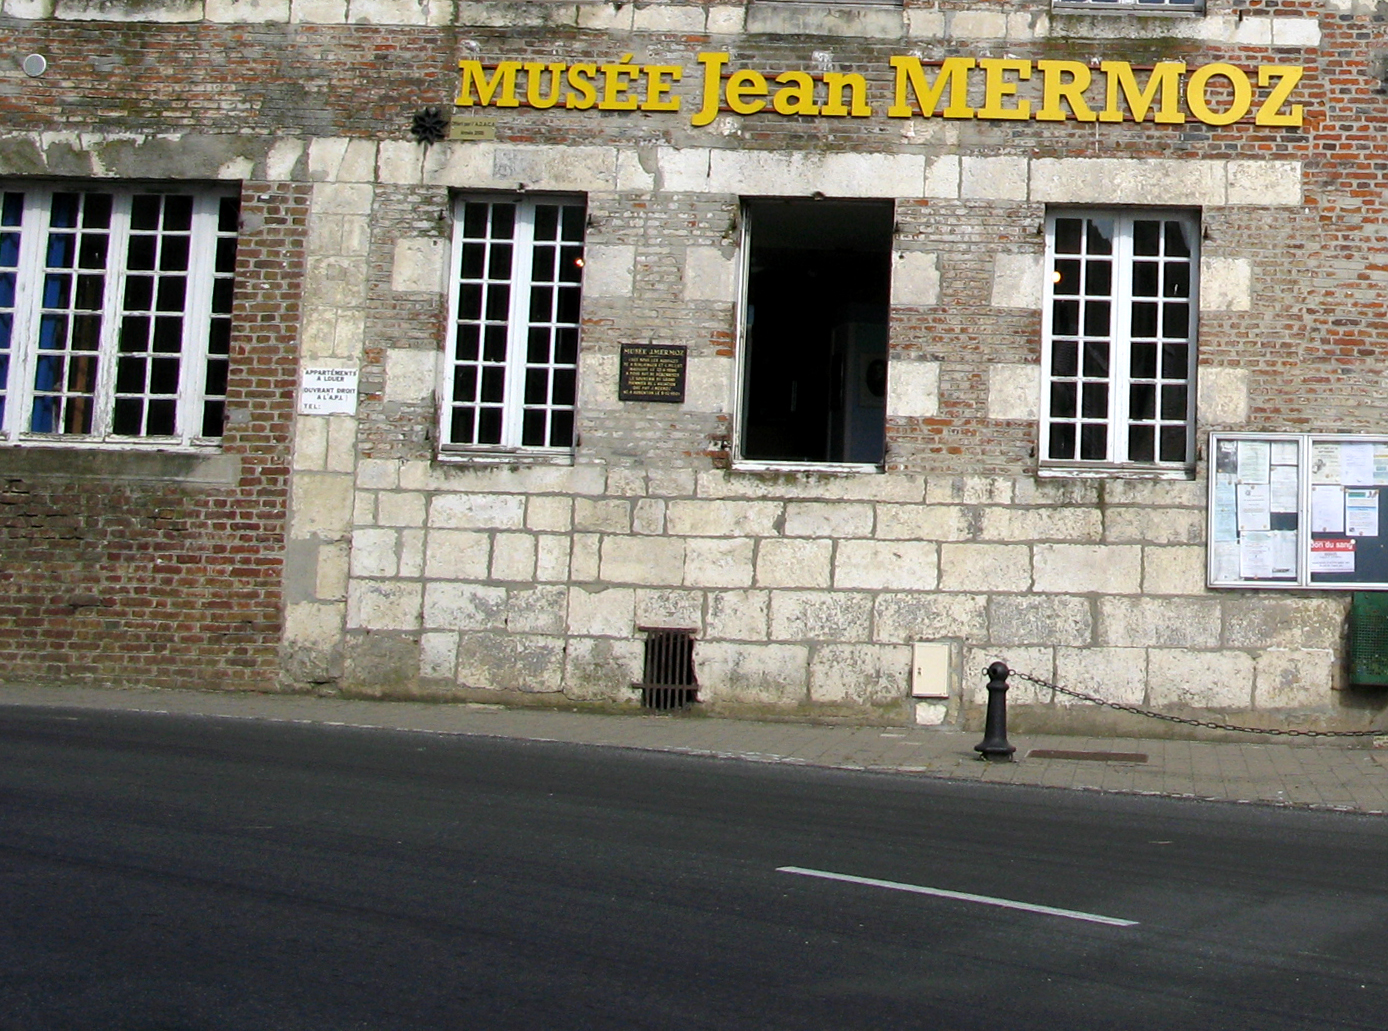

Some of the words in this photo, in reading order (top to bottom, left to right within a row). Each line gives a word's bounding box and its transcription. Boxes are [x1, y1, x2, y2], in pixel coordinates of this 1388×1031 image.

[455, 53, 683, 111] MUSÉE
[690, 52, 872, 126] Jean
[887, 56, 1304, 127] MERMOZ
